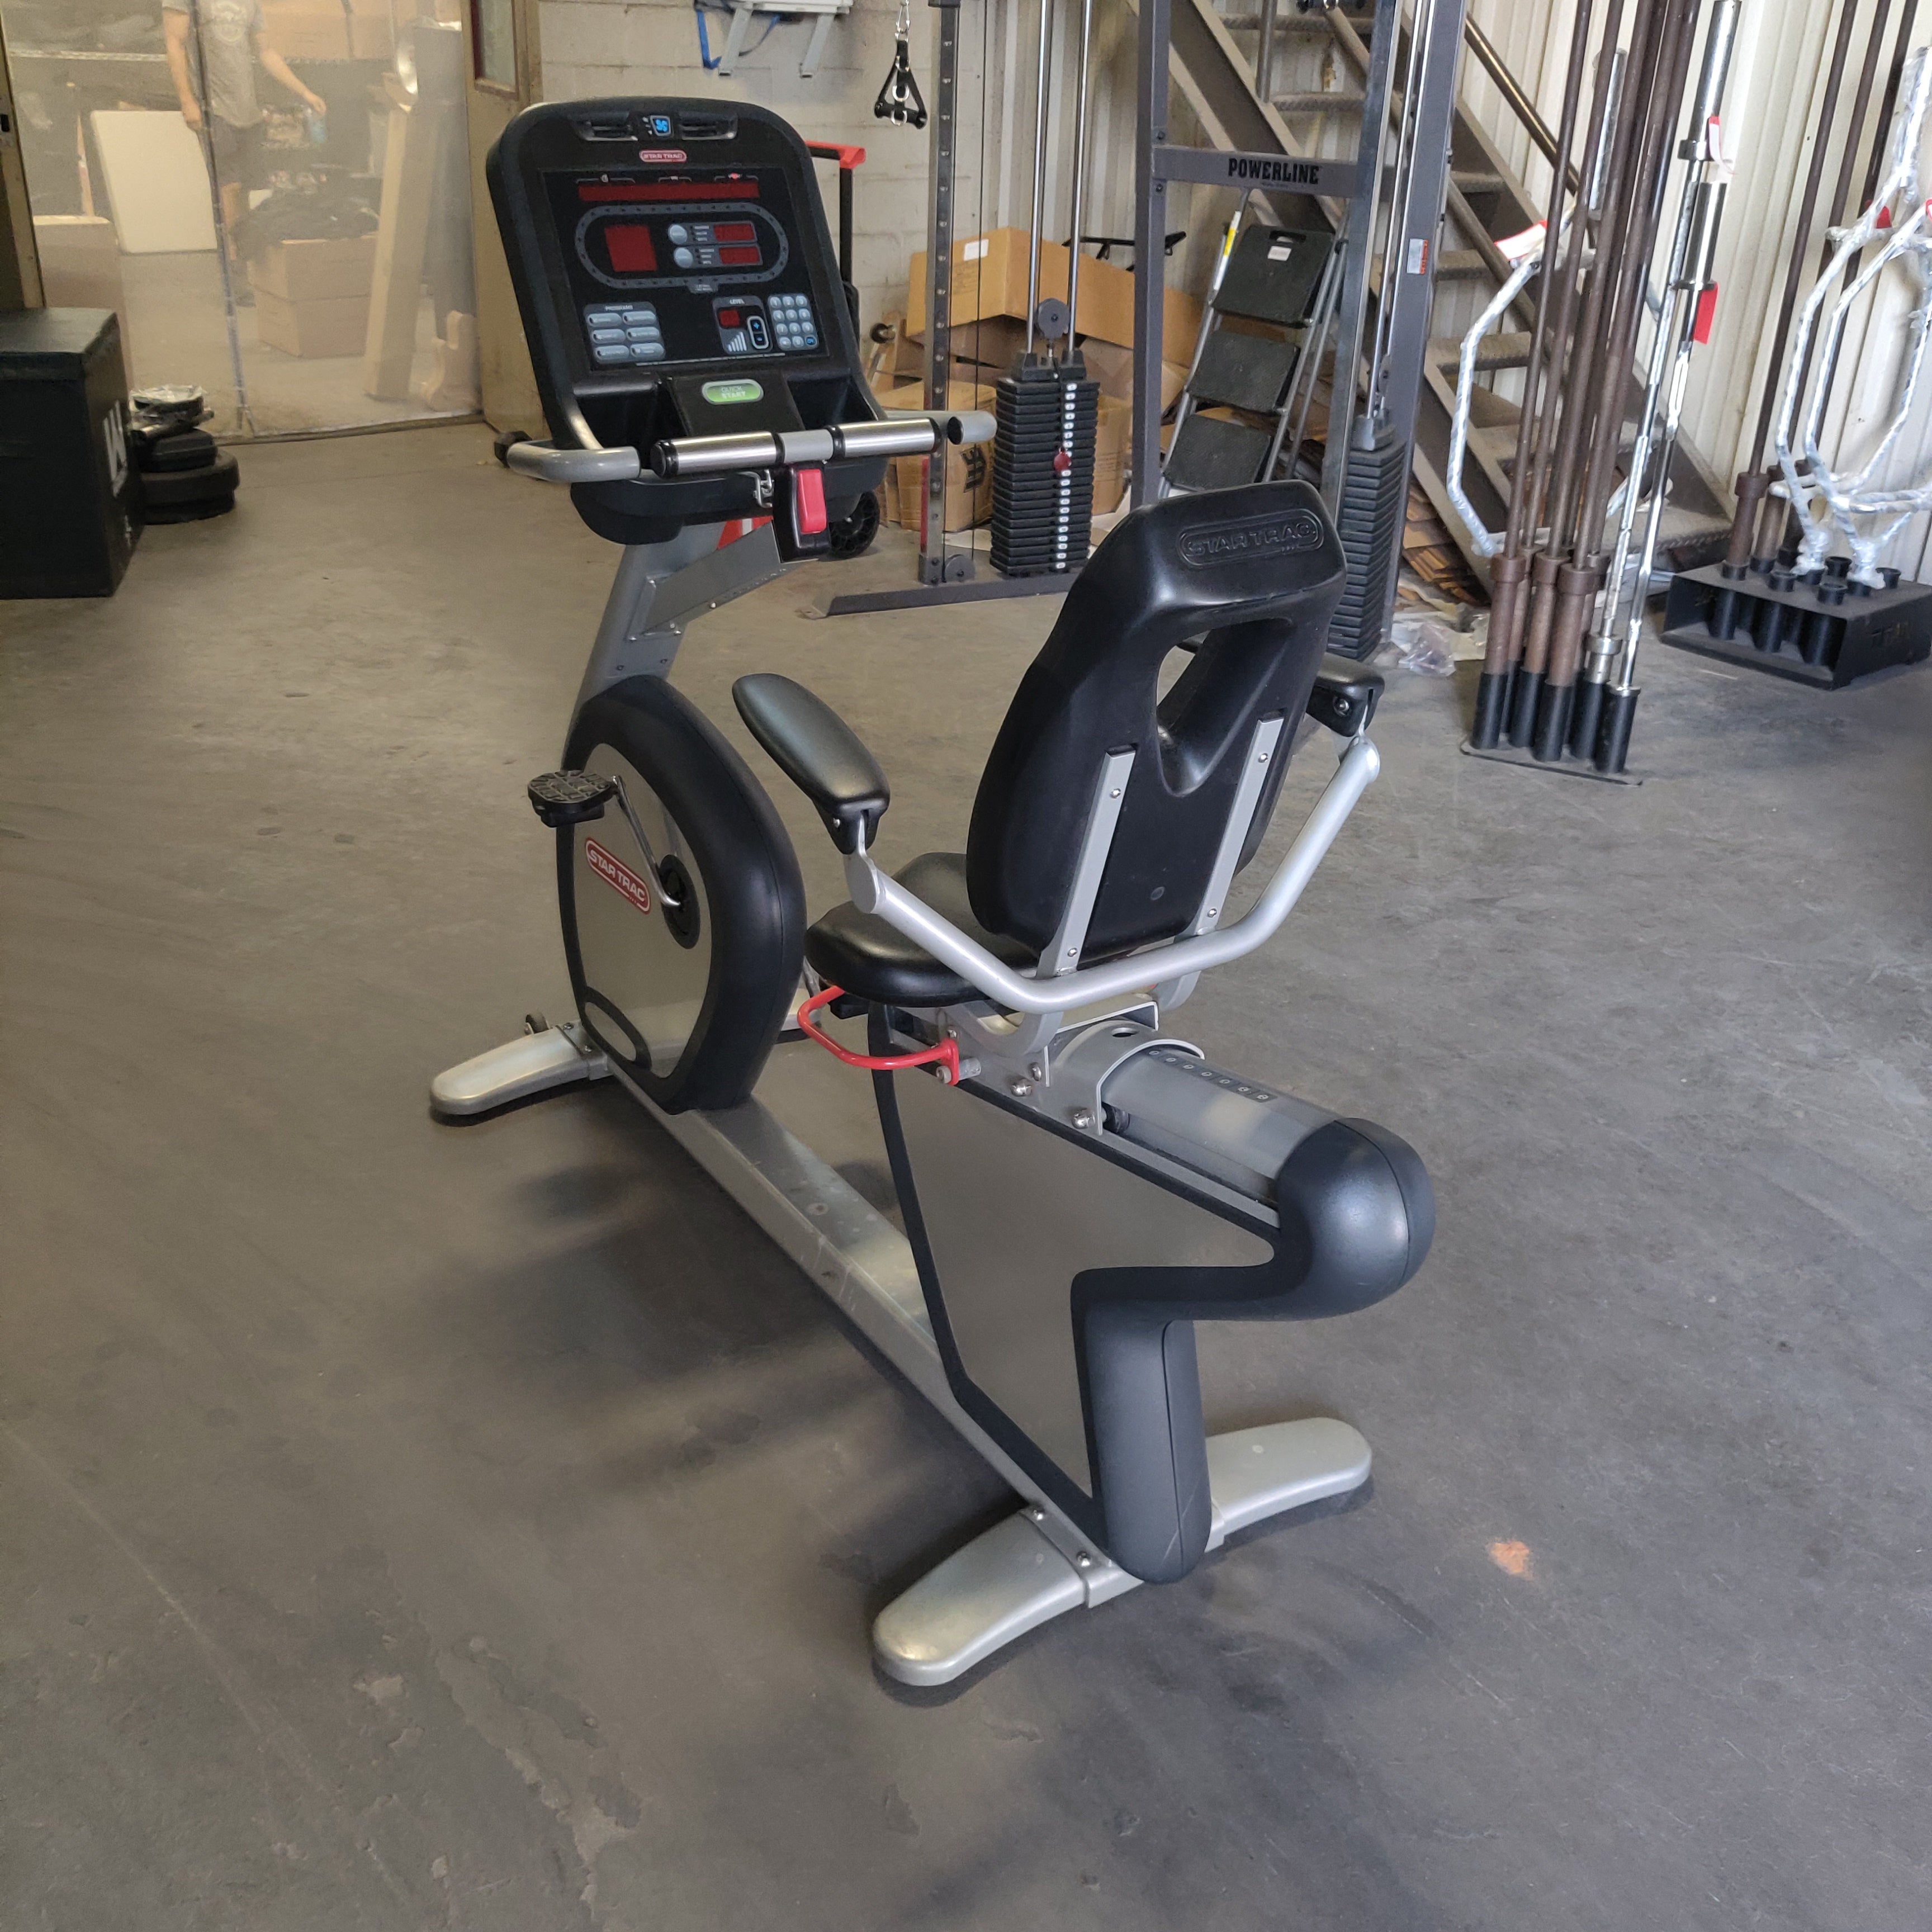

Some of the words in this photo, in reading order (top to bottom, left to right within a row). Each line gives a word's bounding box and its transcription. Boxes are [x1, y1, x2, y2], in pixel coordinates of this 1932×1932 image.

[1228, 158, 1319, 184] POWERLINE
[588, 849, 615, 878] STAR
[617, 870, 645, 902] TRAC
